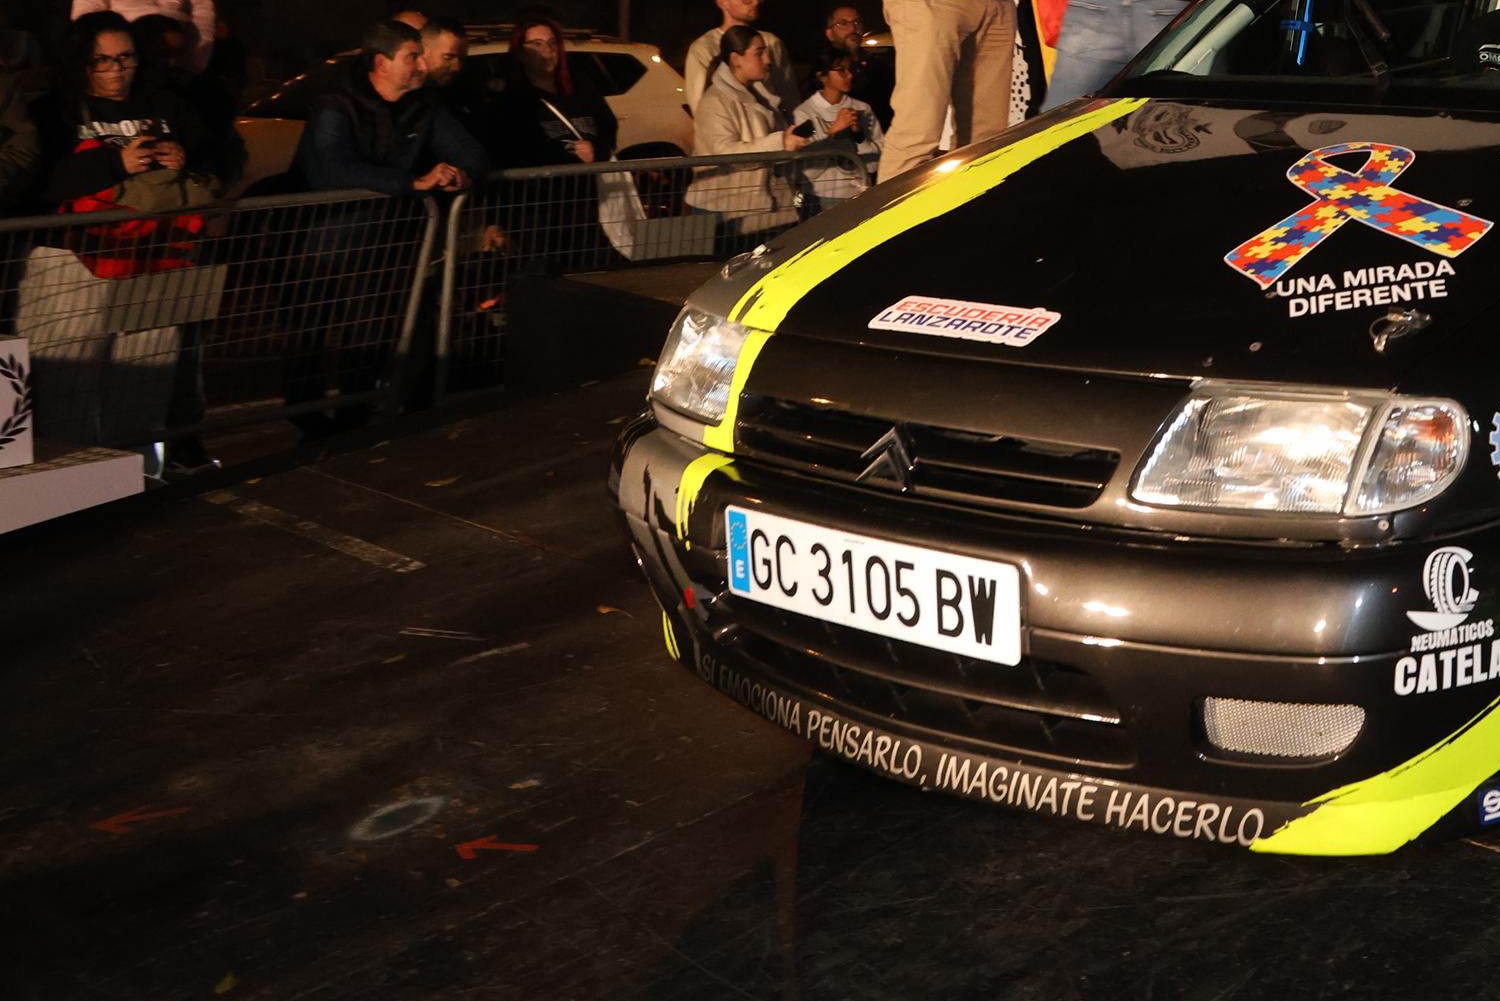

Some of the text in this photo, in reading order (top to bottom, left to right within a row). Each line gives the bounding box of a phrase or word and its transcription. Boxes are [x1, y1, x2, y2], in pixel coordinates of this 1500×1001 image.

[1276, 258, 1456, 298] UNA MIRADA
[1288, 280, 1449, 319] DIFERENTE
[878, 311, 1039, 340] LANZAROTE
[736, 559, 745, 579] E
[750, 528, 998, 647] GC 3105 BW
[1410, 618, 1495, 653] NEUMATICOS
[701, 654, 1265, 850] SI EMOCIONA PENSARLO, IMAGINATE HACERLO
